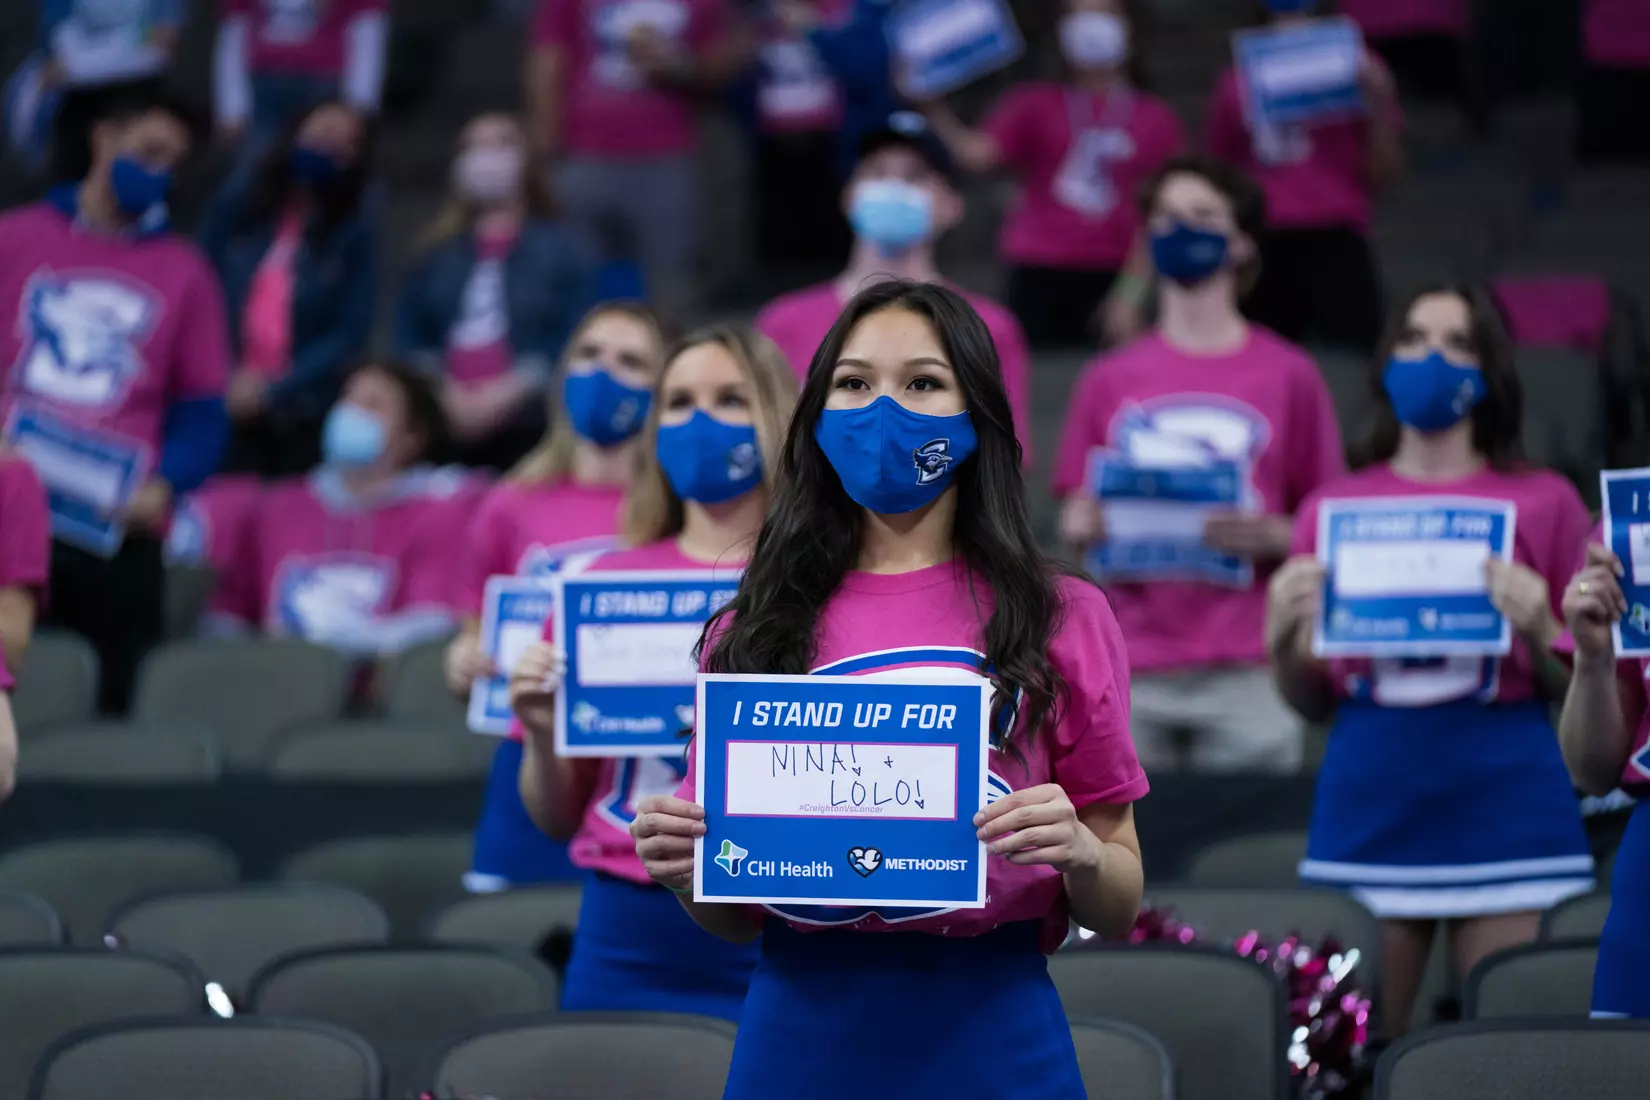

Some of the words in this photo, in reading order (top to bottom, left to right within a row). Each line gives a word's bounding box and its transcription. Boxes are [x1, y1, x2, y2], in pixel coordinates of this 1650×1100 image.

[732, 700, 743, 726] I
[751, 701, 844, 728] STAND
[853, 702, 892, 729] UP
[900, 703, 957, 730] FOR
[772, 742, 861, 777] NINA!
[830, 779, 925, 810] LOLO!
[747, 860, 775, 877] CHI
[780, 861, 834, 878] Health
[885, 858, 968, 872] METHODIST
